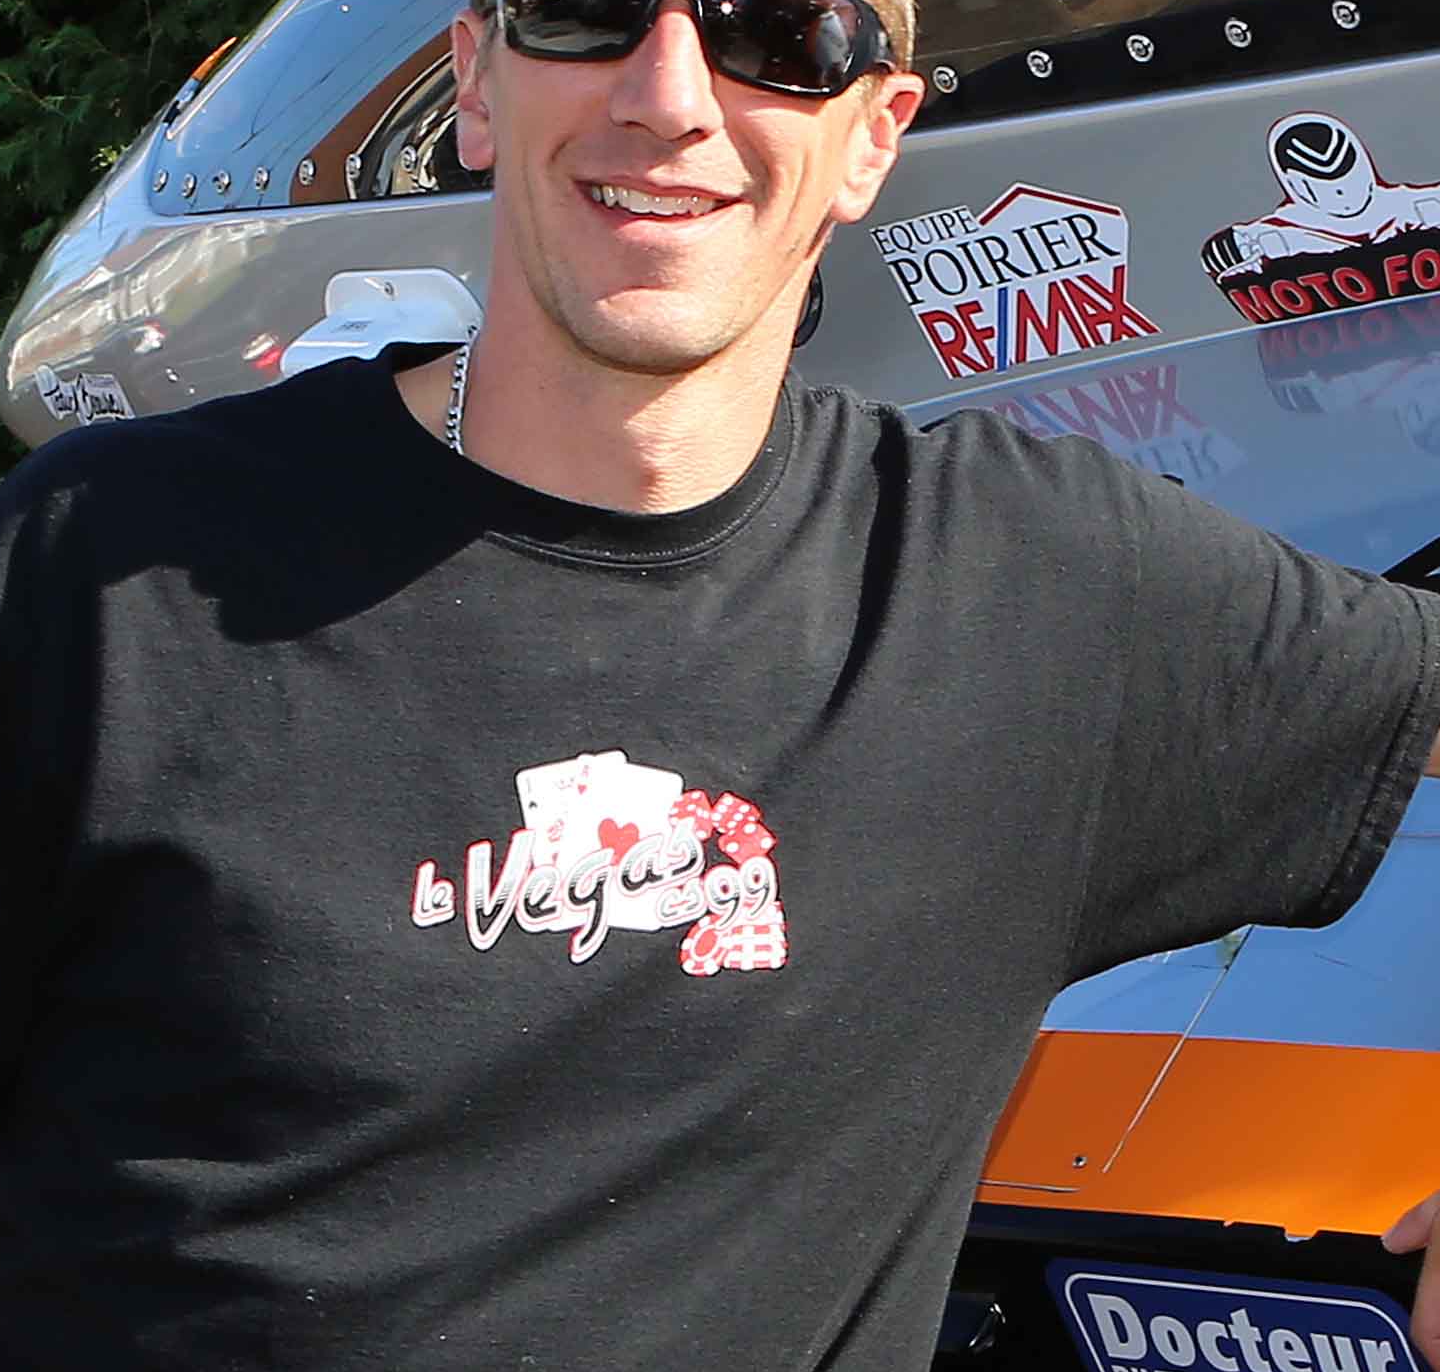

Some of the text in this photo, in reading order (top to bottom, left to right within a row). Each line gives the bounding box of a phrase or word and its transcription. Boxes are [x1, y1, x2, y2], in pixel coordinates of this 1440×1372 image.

[887, 212, 1122, 306] POIRIER
[1228, 267, 1378, 325] MOTO
[919, 264, 1162, 379] RE/MAX
[467, 818, 707, 966] Vegas
